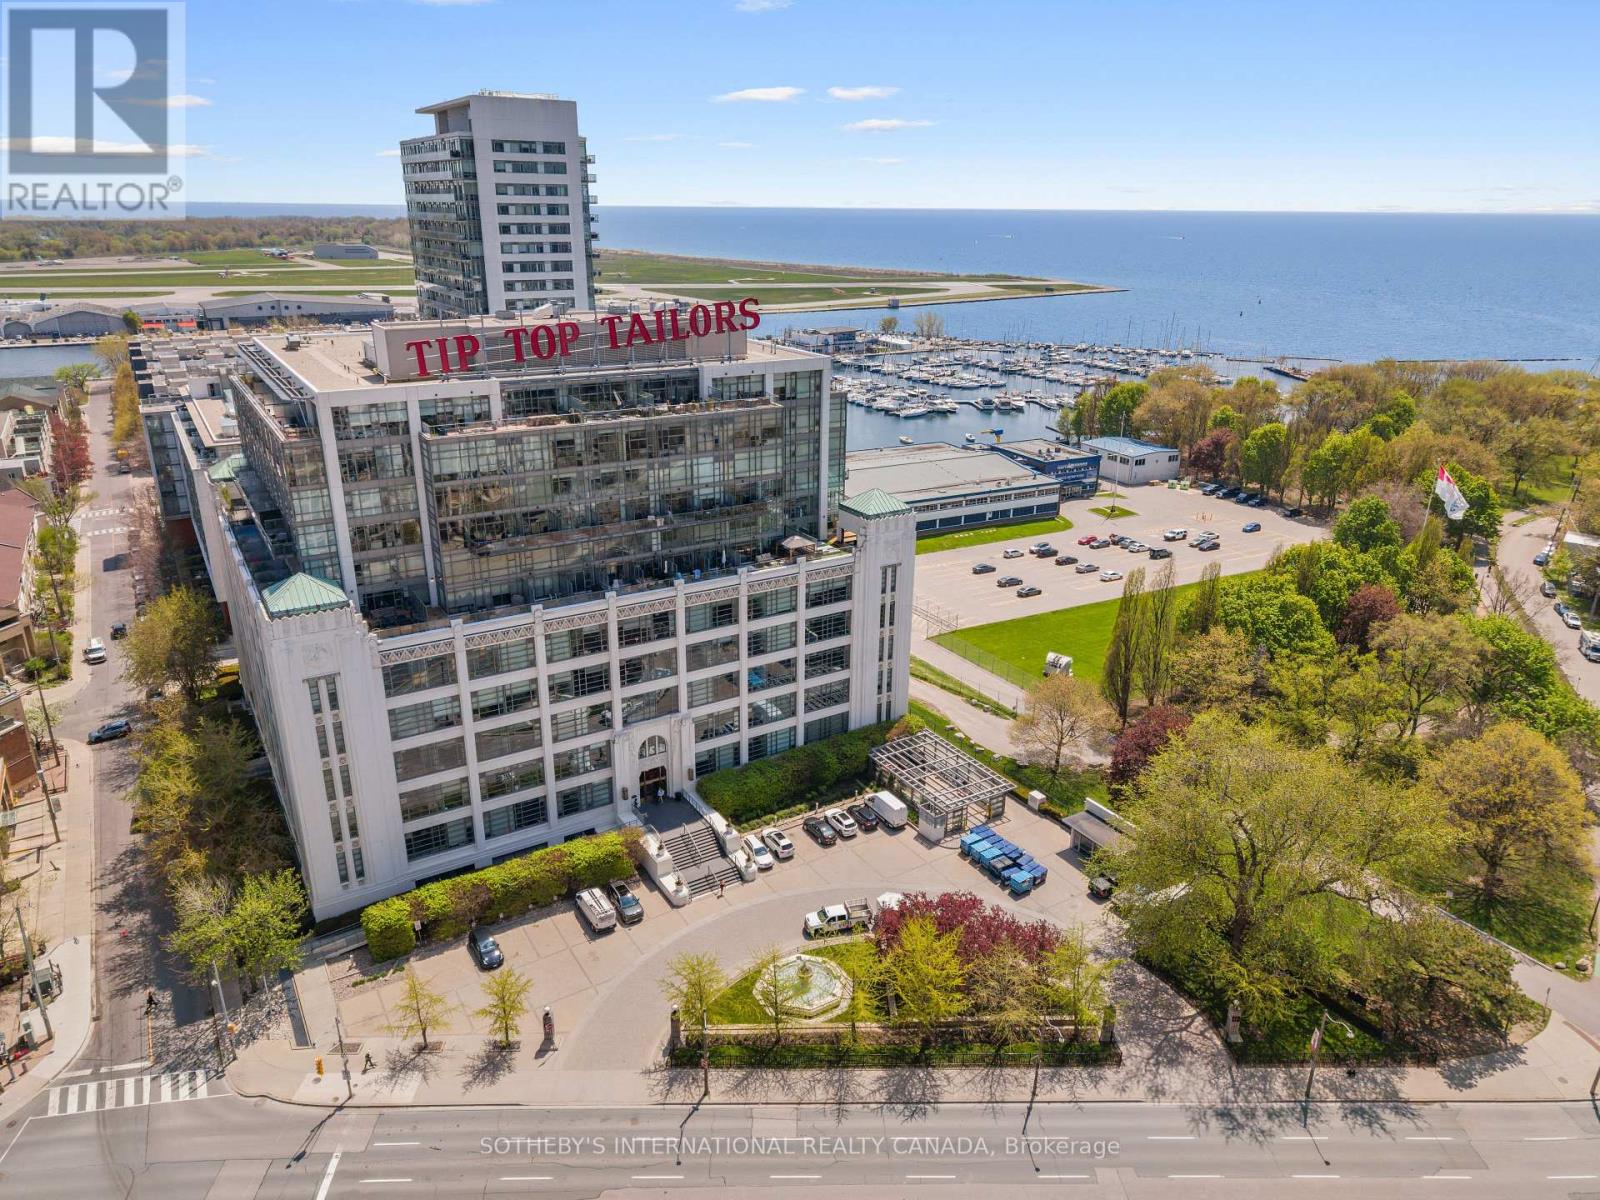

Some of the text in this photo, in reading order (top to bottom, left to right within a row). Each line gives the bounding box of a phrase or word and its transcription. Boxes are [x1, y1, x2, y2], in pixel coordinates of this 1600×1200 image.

[406, 297, 761, 377] TIP TOP TAILORS
